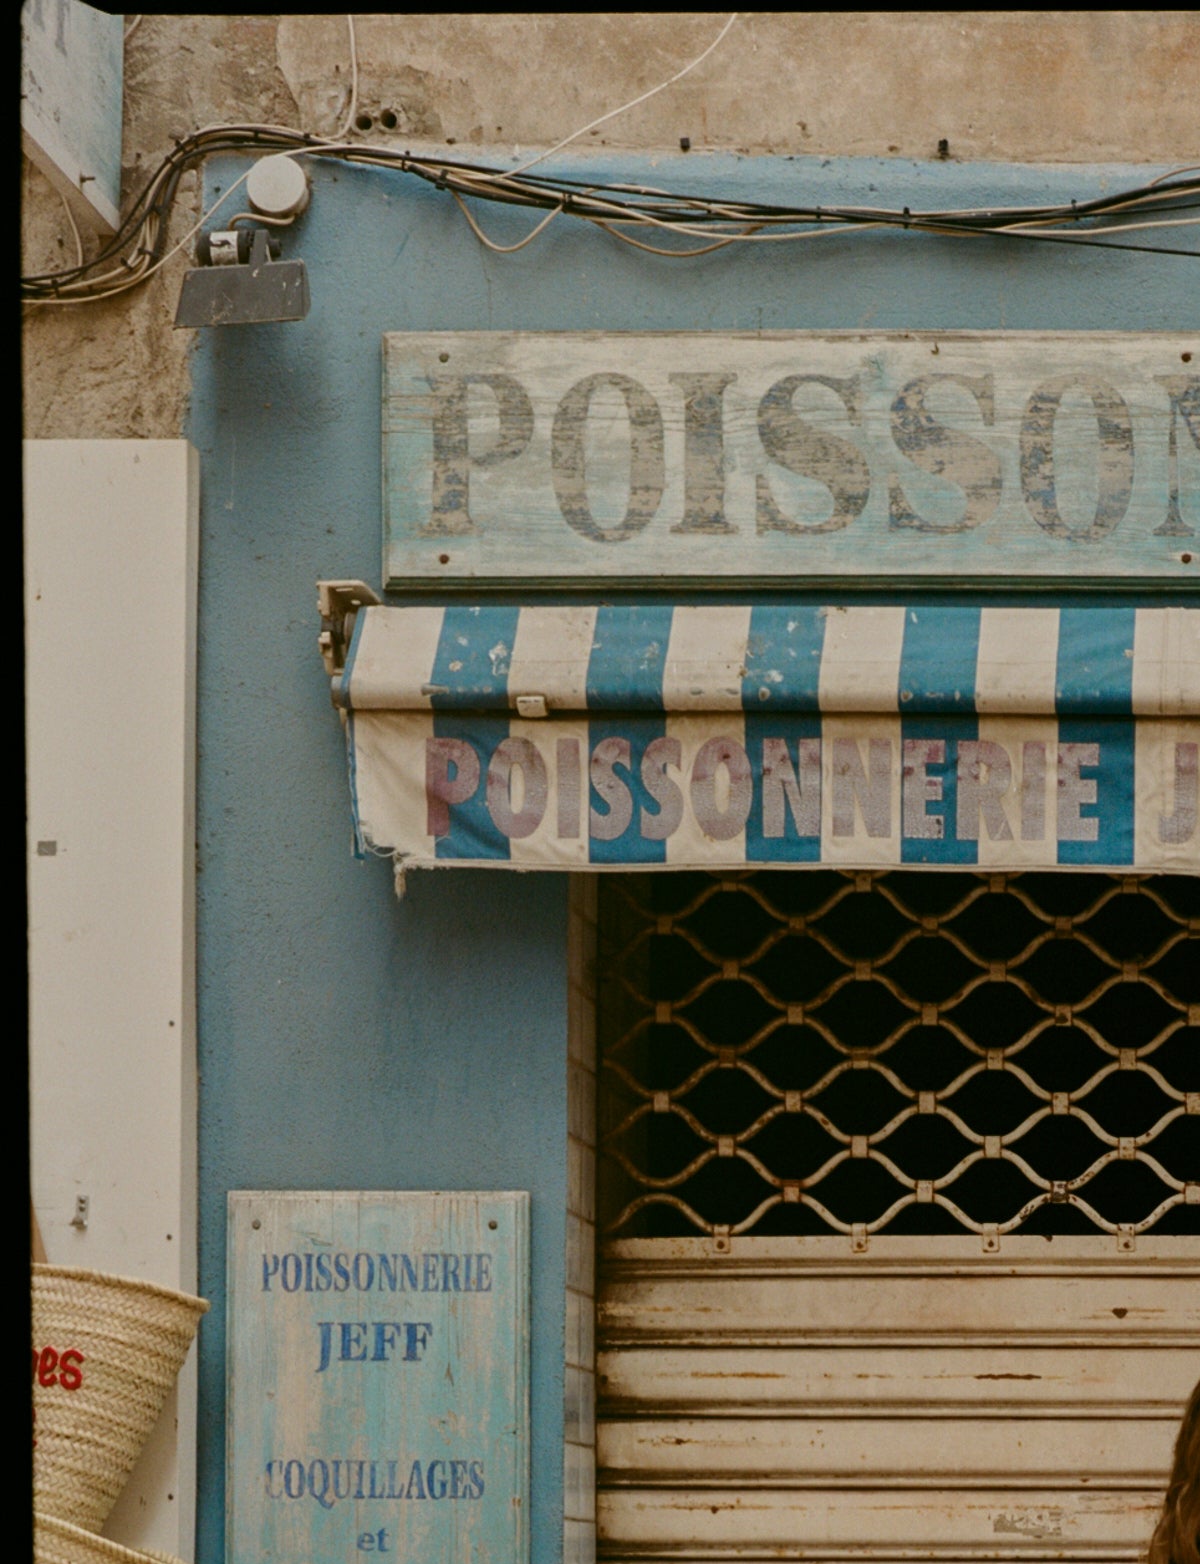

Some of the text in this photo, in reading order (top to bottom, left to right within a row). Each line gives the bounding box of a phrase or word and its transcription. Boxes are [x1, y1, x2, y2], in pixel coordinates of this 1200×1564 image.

[424, 736, 1100, 842] POISSONNERIE
[261, 1252, 493, 1293] POISSONNERIE
[315, 1321, 434, 1372] JEFF
[264, 1459, 486, 1509] COQUILLAGES
[356, 1526, 391, 1553] et
